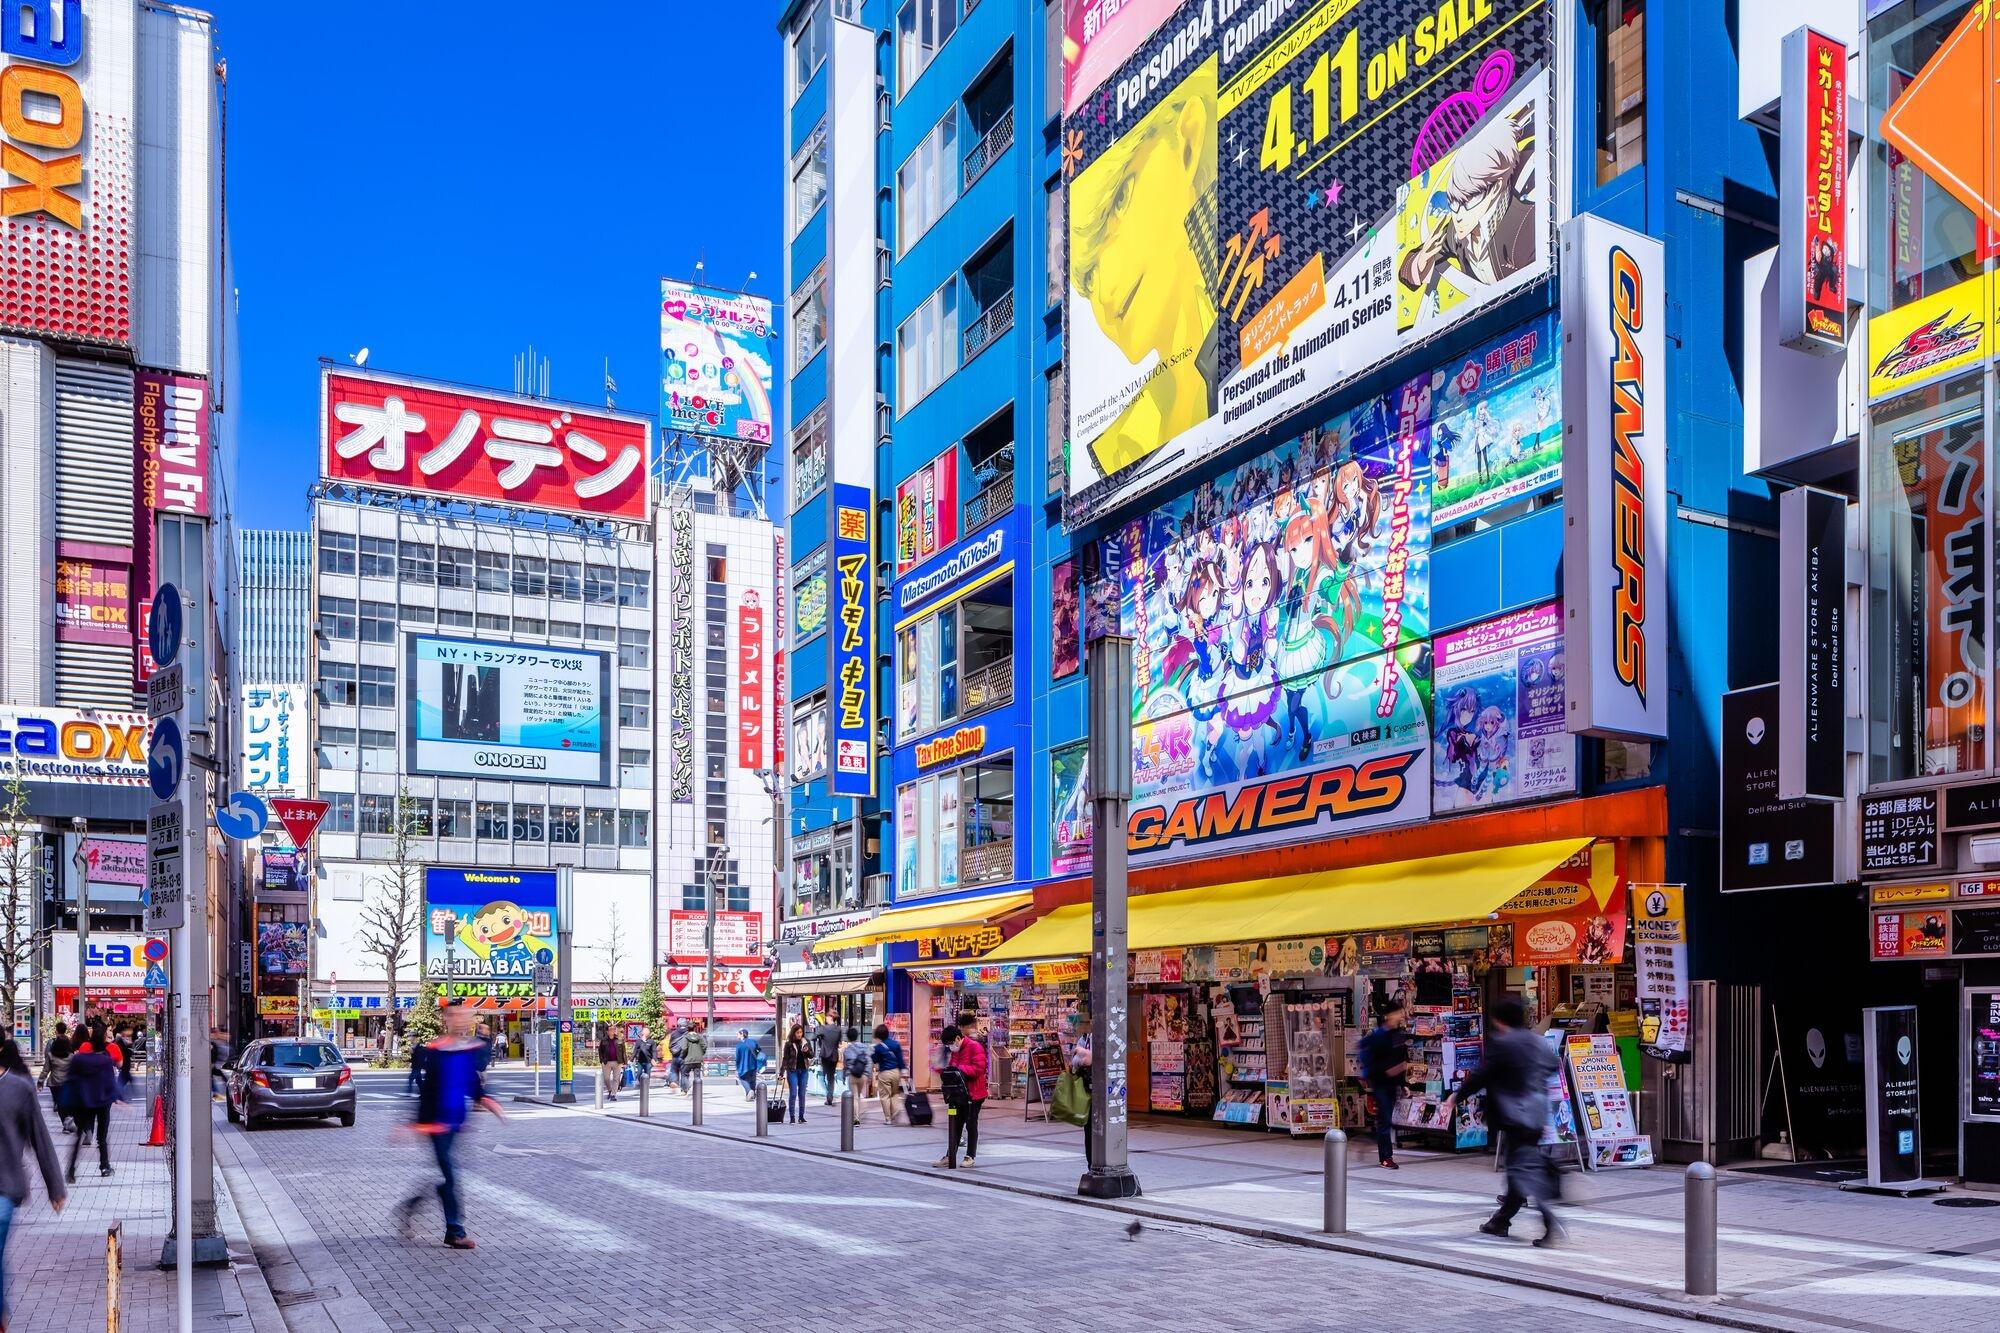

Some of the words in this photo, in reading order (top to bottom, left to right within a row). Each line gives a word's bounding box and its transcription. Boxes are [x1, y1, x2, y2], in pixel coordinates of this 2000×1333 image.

[1260, 27, 1358, 174] 4.11
[1367, 35, 1407, 101] ON
[1415, 0, 1493, 66] SALE
[1818, 67, 1834, 235] カードキングダム
[1373, 256, 1392, 276] 同時
[1333, 269, 1370, 310] 4.11
[1373, 273, 1392, 290] 発売
[1243, 300, 1285, 347] オリジナル
[1254, 281, 1319, 352] サウンドトラック
[1224, 361, 1270, 405] Persona4
[1272, 353, 1290, 374] the
[1292, 317, 1349, 366] Animation
[1352, 294, 1392, 331] Series
[1485, 331, 1537, 371] 購買部
[1119, 360, 1169, 400] ANIMATION
[1170, 346, 1193, 367] Series
[684, 395, 725, 412] LOVE
[1223, 394, 1255, 425] Original
[1257, 368, 1306, 407] Soundtrack
[140, 382, 160, 454] Flagship
[160, 385, 204, 468] Duty
[334, 396, 640, 498] オノデン
[142, 459, 158, 508] Store
[1609, 245, 1646, 712] GAMERS
[841, 510, 865, 539] 薬
[57, 561, 92, 577] 本店
[903, 562, 958, 602] Matsumoto
[959, 533, 1000, 573] KiYoshi
[1810, 545, 1819, 594] AKIBA
[56, 579, 127, 600] 総合家電
[1810, 597, 1819, 647] STORE
[1831, 607, 1839, 633] Site
[838, 554, 867, 729] マツモトキヨシ
[1446, 614, 1559, 655] 超次元ビジュアルクロニクル
[1831, 636, 1839, 661] Real
[1831, 664, 1839, 688] Dell
[741, 617, 761, 762] ラブメルシー
[1810, 652, 1819, 742] ALIENWARE
[916, 744, 932, 766] Tax
[934, 736, 954, 762] Free
[955, 727, 982, 758] Shop
[1361, 729, 1377, 740] 検索
[106, 764, 147, 777] Store
[474, 752, 547, 769] ONODEN
[842, 756, 865, 768] 免税
[1746, 780, 1777, 791] STORE
[1127, 749, 1426, 852] GAMERS
[1865, 797, 1936, 817] お部屋探し
[283, 809, 318, 821] 止まれ
[1891, 815, 1935, 830] iDEAL
[490, 823, 580, 842] MODFY
[1891, 828, 1935, 839] アイデアル
[1866, 845, 1897, 857] 当ビル
[1899, 841, 1916, 854] 8F
[1866, 854, 1917, 867] 入口はこちら
[464, 873, 510, 883] Welcome
[510, 874, 521, 884] to
[1967, 883, 1981, 894] 6F
[1638, 919, 1680, 931] MONEY
[1638, 932, 1681, 940] EXCHANGE
[1879, 924, 1899, 933] 鉄道
[1878, 942, 1899, 950] TOY
[86, 970, 131, 978] KIHABARA
[1575, 1064, 1617, 1073] EXCHANGE
